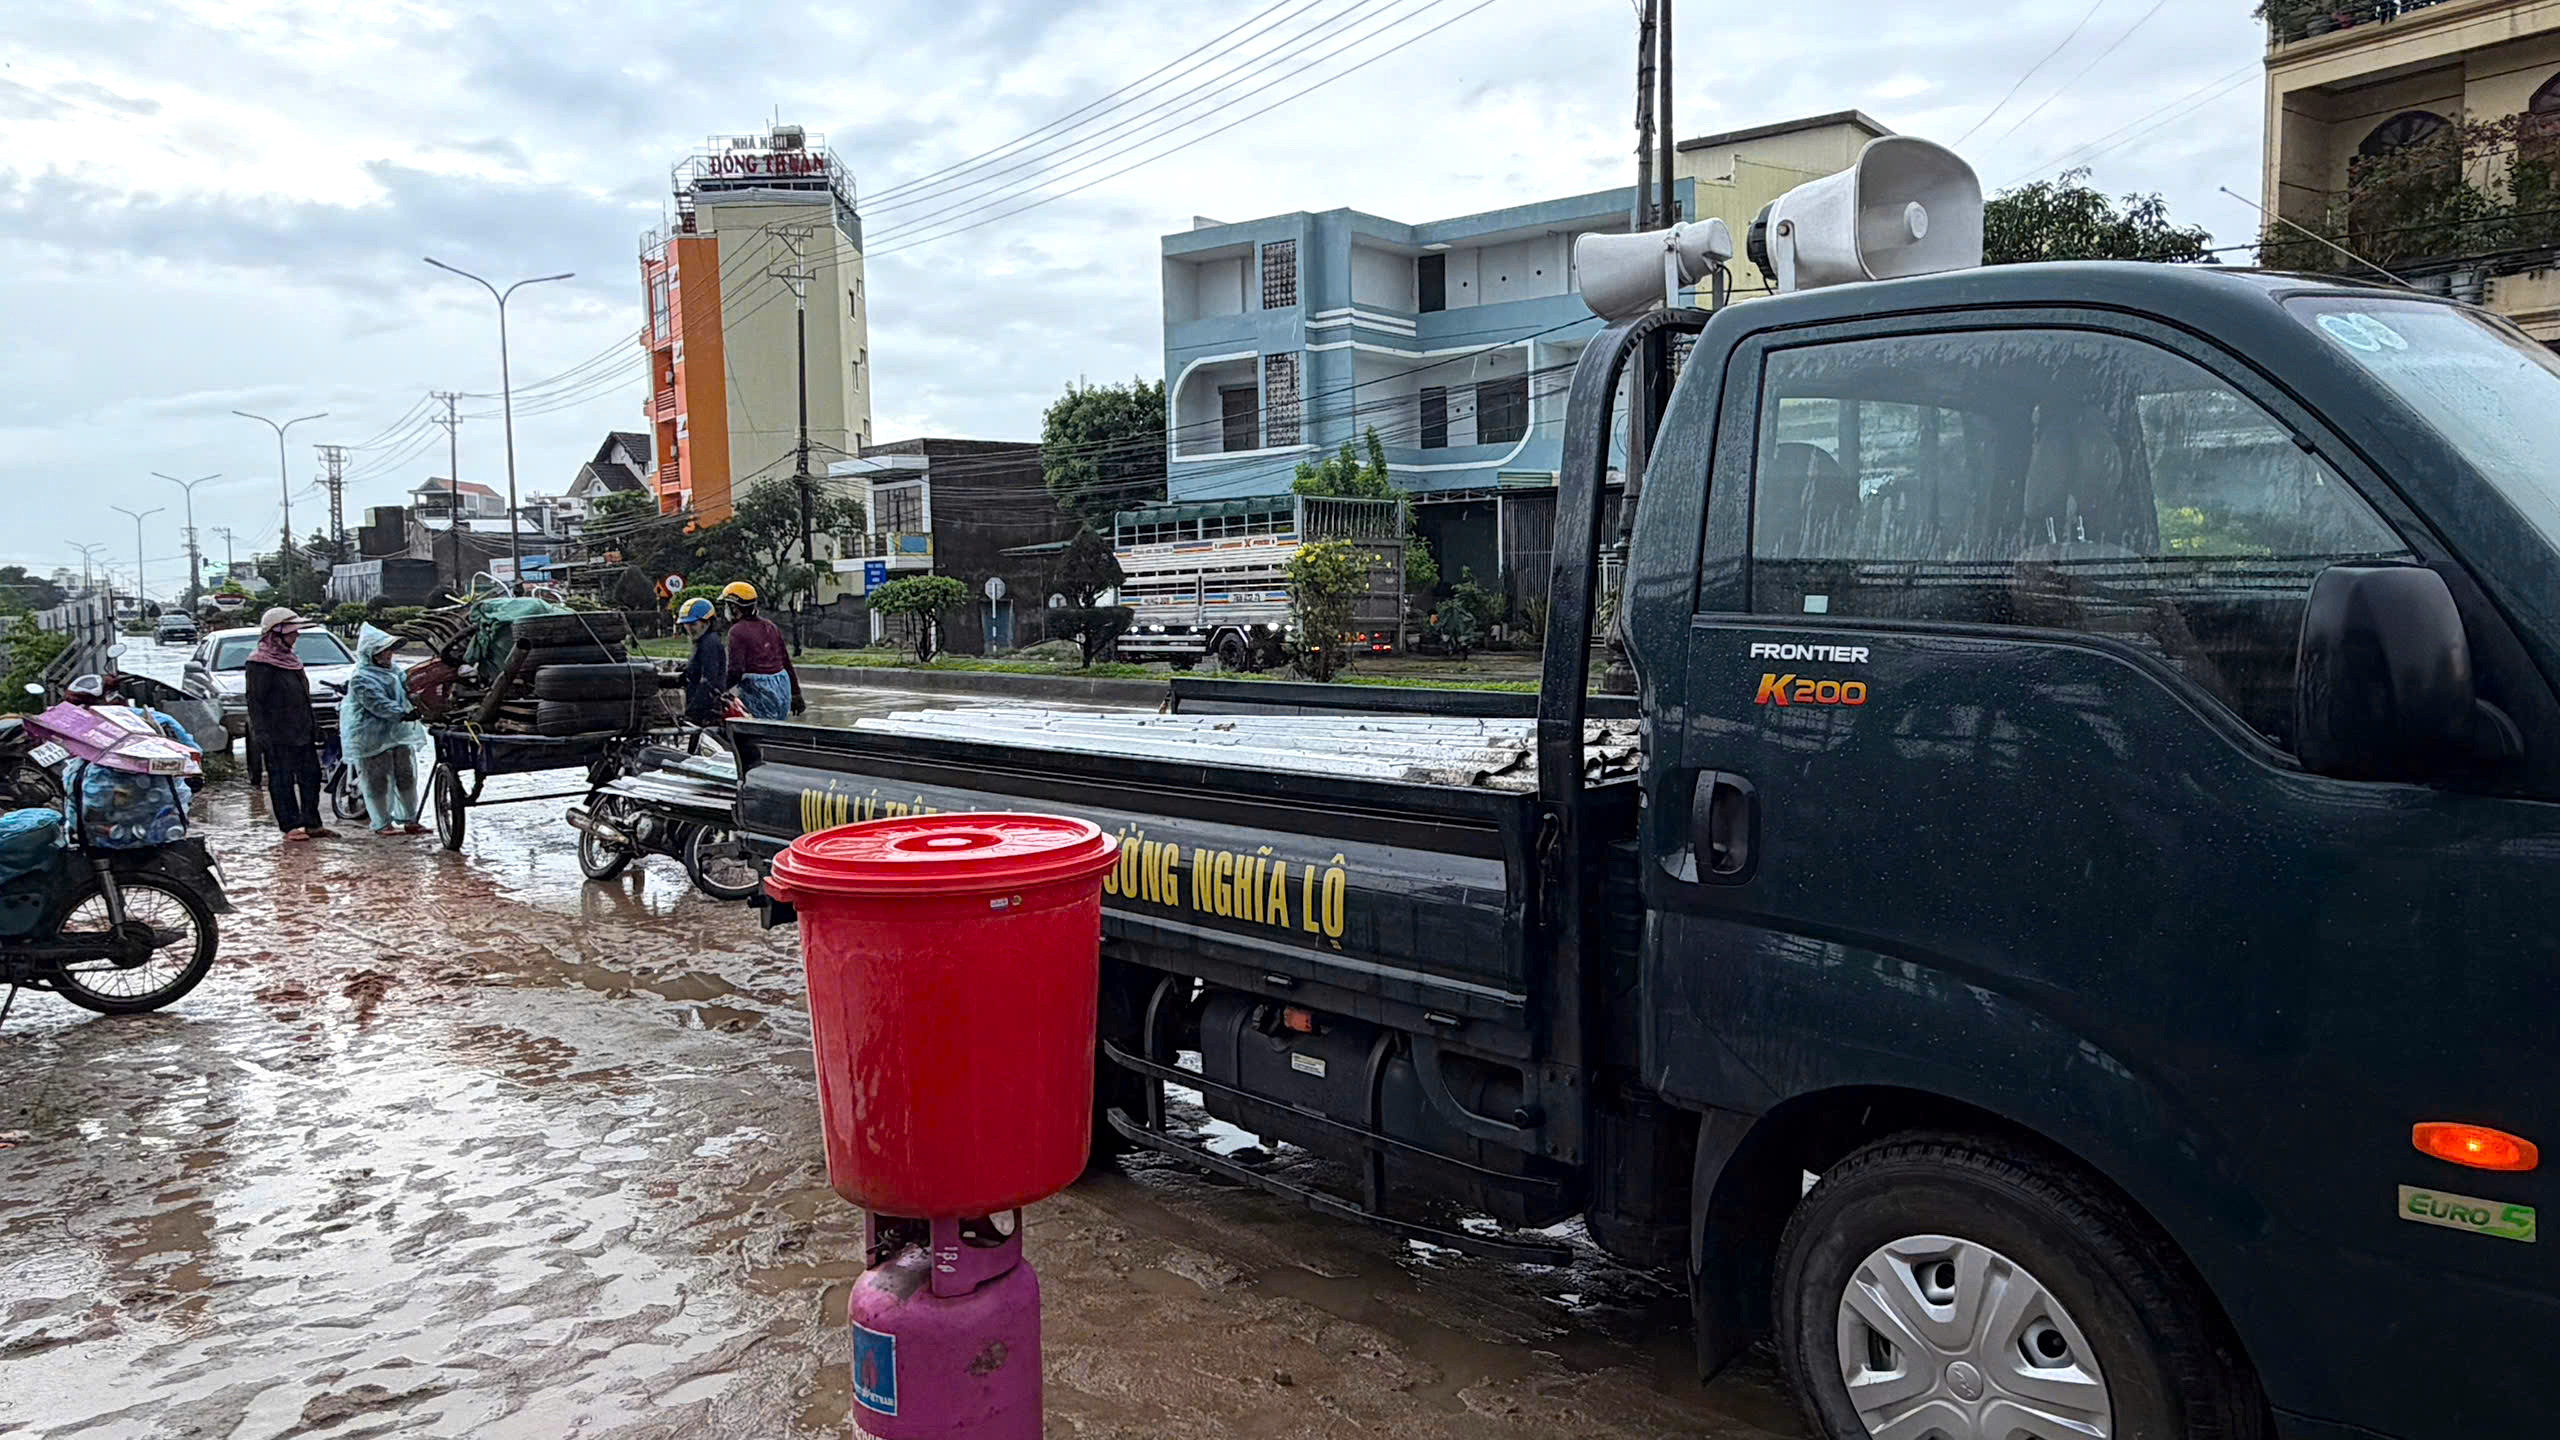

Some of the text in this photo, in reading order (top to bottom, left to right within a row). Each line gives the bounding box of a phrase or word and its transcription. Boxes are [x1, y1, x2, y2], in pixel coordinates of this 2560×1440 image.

[669, 579, 681, 588] 40
[1750, 642, 1869, 664] FRONTIER
[1754, 673, 1867, 707] K200
[1192, 845, 1291, 928] NGHĨA
[1303, 853, 1346, 950] LỘ
[2407, 1193, 2535, 1238] EURO 5
